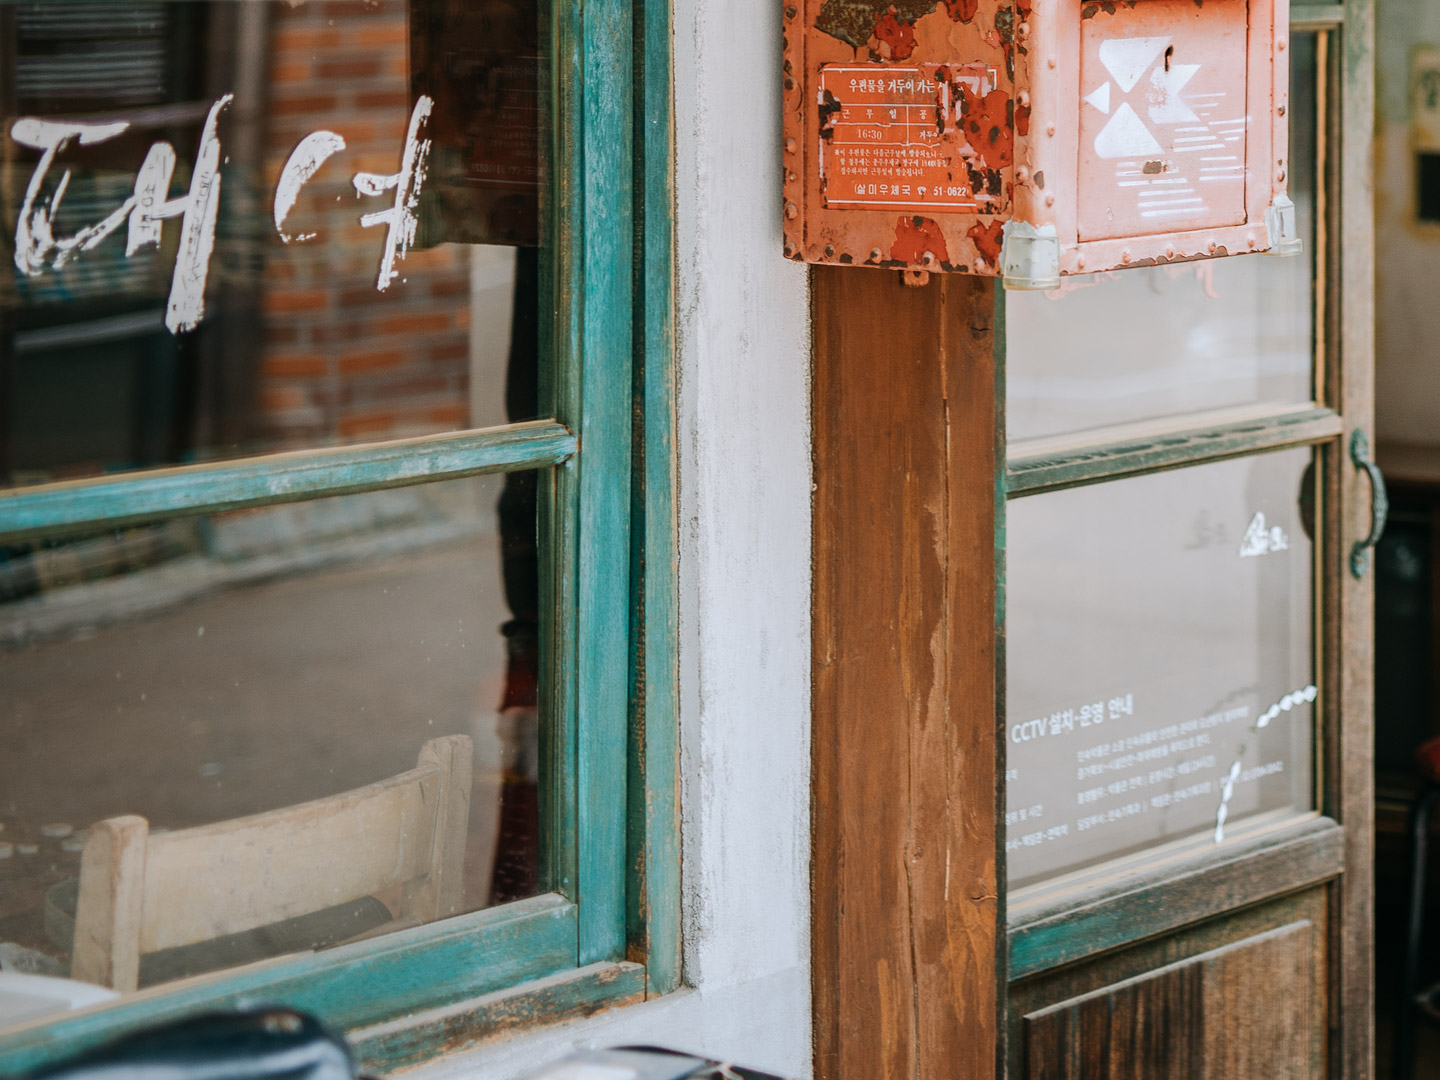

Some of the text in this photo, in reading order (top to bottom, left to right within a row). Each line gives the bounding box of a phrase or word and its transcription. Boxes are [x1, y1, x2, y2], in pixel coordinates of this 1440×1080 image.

[848, 78, 885, 93] 우편물을
[916, 78, 935, 93] 가는
[857, 128, 882, 140] 16:30
[1010, 717, 1048, 744] CCTV
[1107, 693, 1134, 720] 안내
